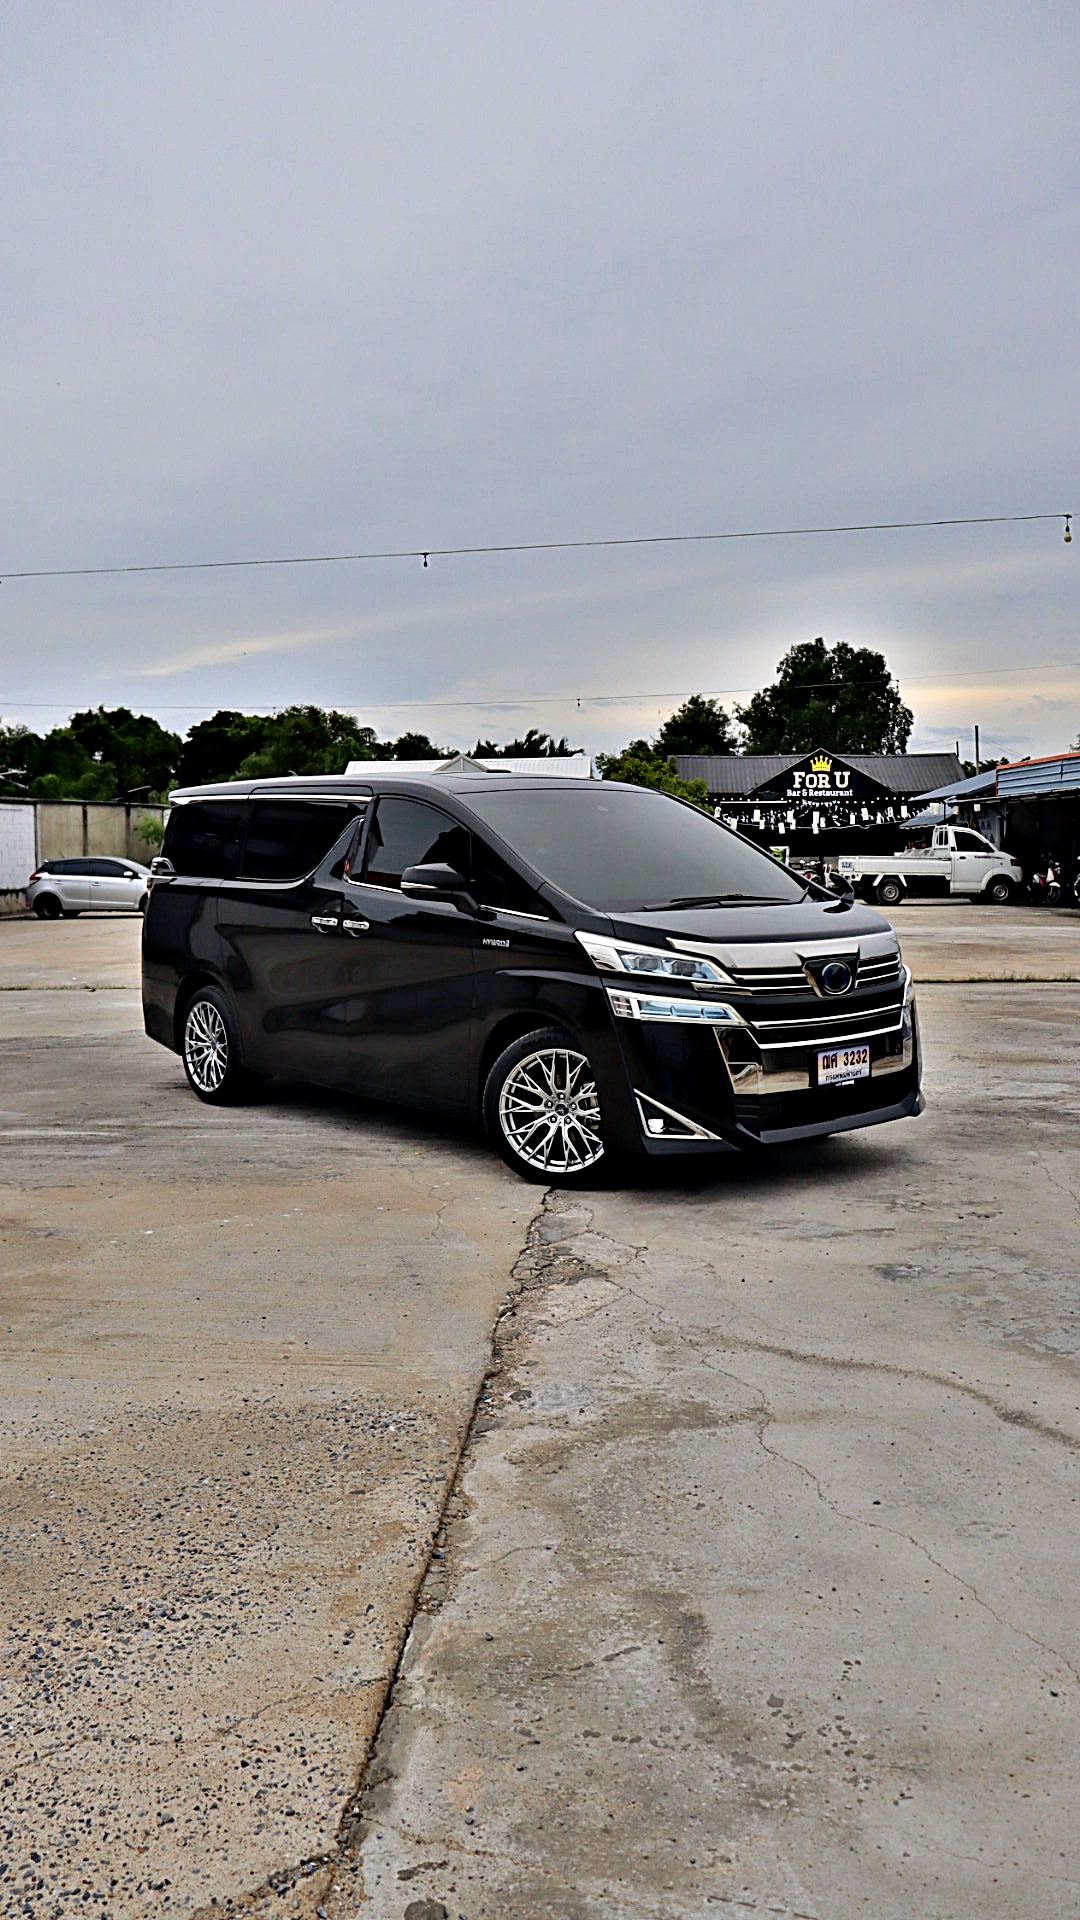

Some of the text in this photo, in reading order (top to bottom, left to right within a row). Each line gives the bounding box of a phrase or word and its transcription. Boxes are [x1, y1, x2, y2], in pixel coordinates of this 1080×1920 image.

[792, 771, 851, 789] FOR U
[786, 788, 853, 797] Bar & Restaurant
[843, 1048, 868, 1067] 3232
